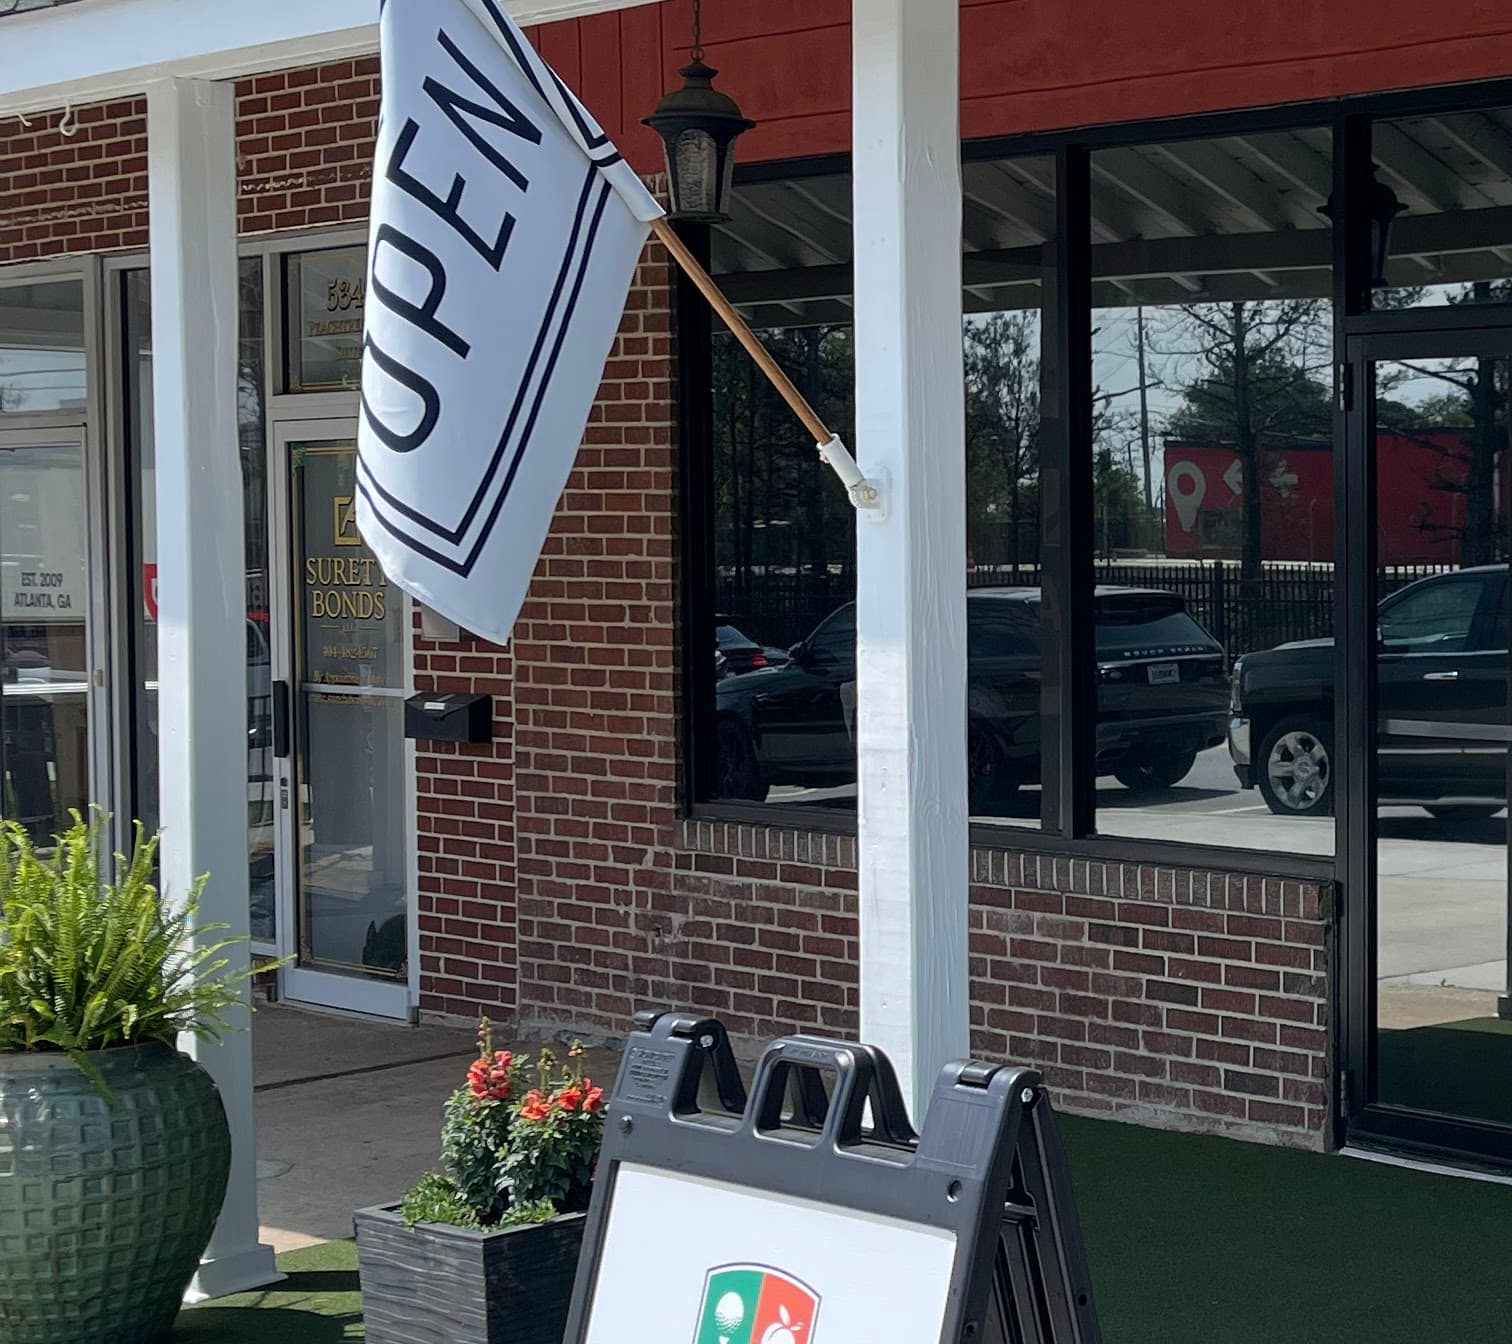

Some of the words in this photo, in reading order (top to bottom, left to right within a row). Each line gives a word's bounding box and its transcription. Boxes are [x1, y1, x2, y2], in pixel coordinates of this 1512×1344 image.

[361, 27, 543, 453] OPEN
[326, 277, 366, 312] 534
[21, 572, 38, 587] EST.
[39, 572, 63, 587] 2009
[14, 592, 55, 610] ATLANTA,
[57, 592, 71, 609] GA
[311, 590, 385, 619] BONDS
